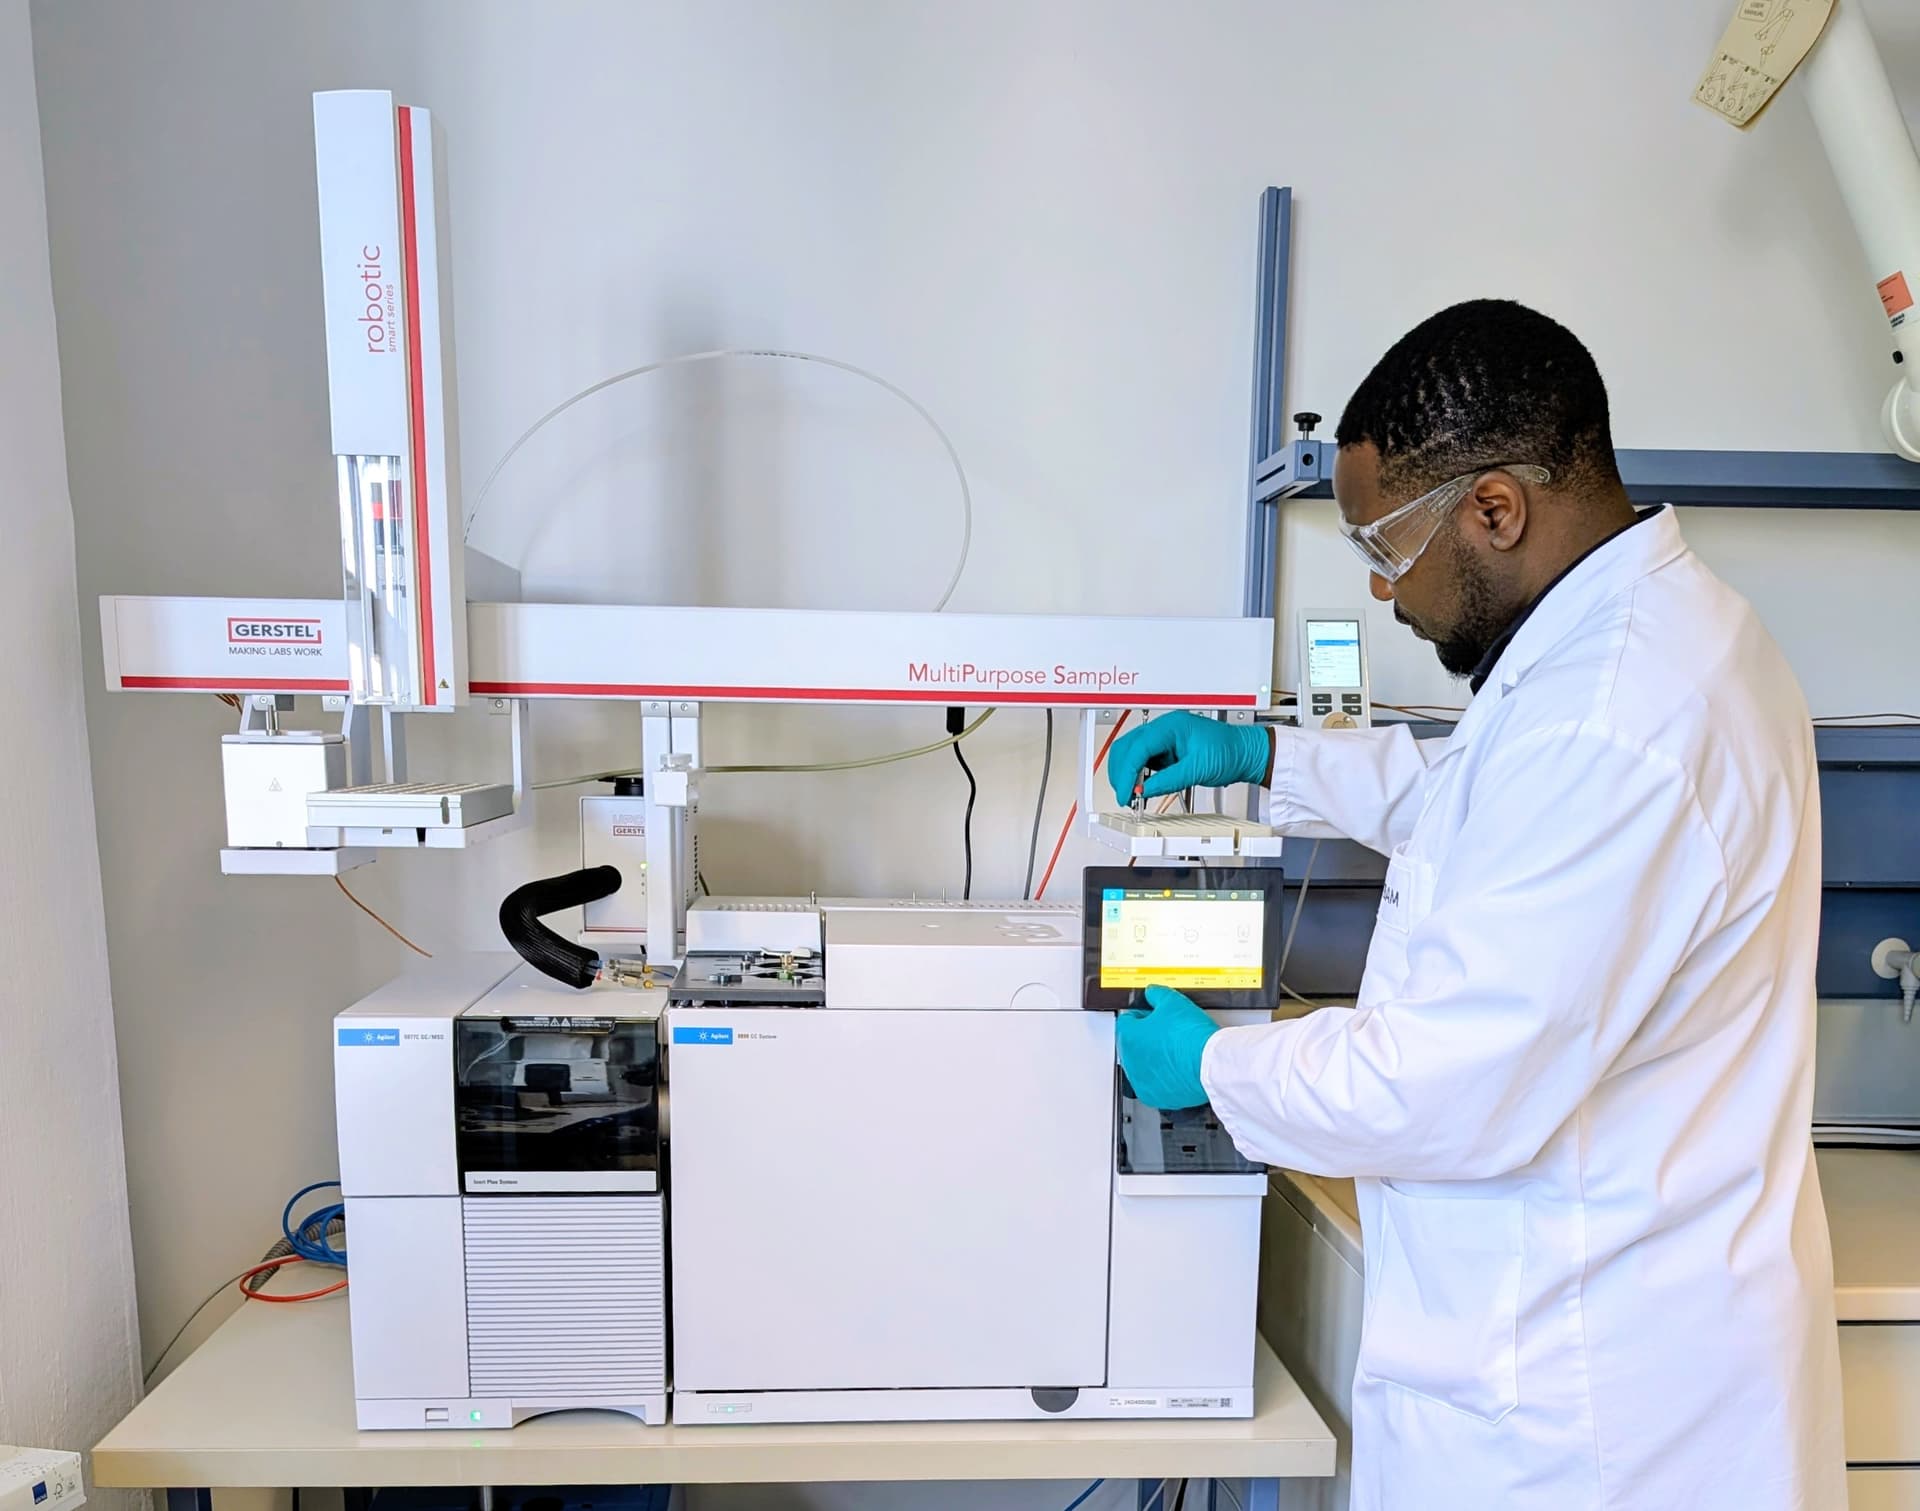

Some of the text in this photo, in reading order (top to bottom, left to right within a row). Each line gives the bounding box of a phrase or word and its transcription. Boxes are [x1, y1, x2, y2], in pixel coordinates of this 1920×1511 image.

[357, 245, 385, 352] robotic
[385, 284, 397, 353] smart series
[235, 624, 314, 638] GERSTEL
[228, 646, 323, 657] MAKING LABS WORK
[908, 662, 1139, 692] MultiPurpose Sampler
